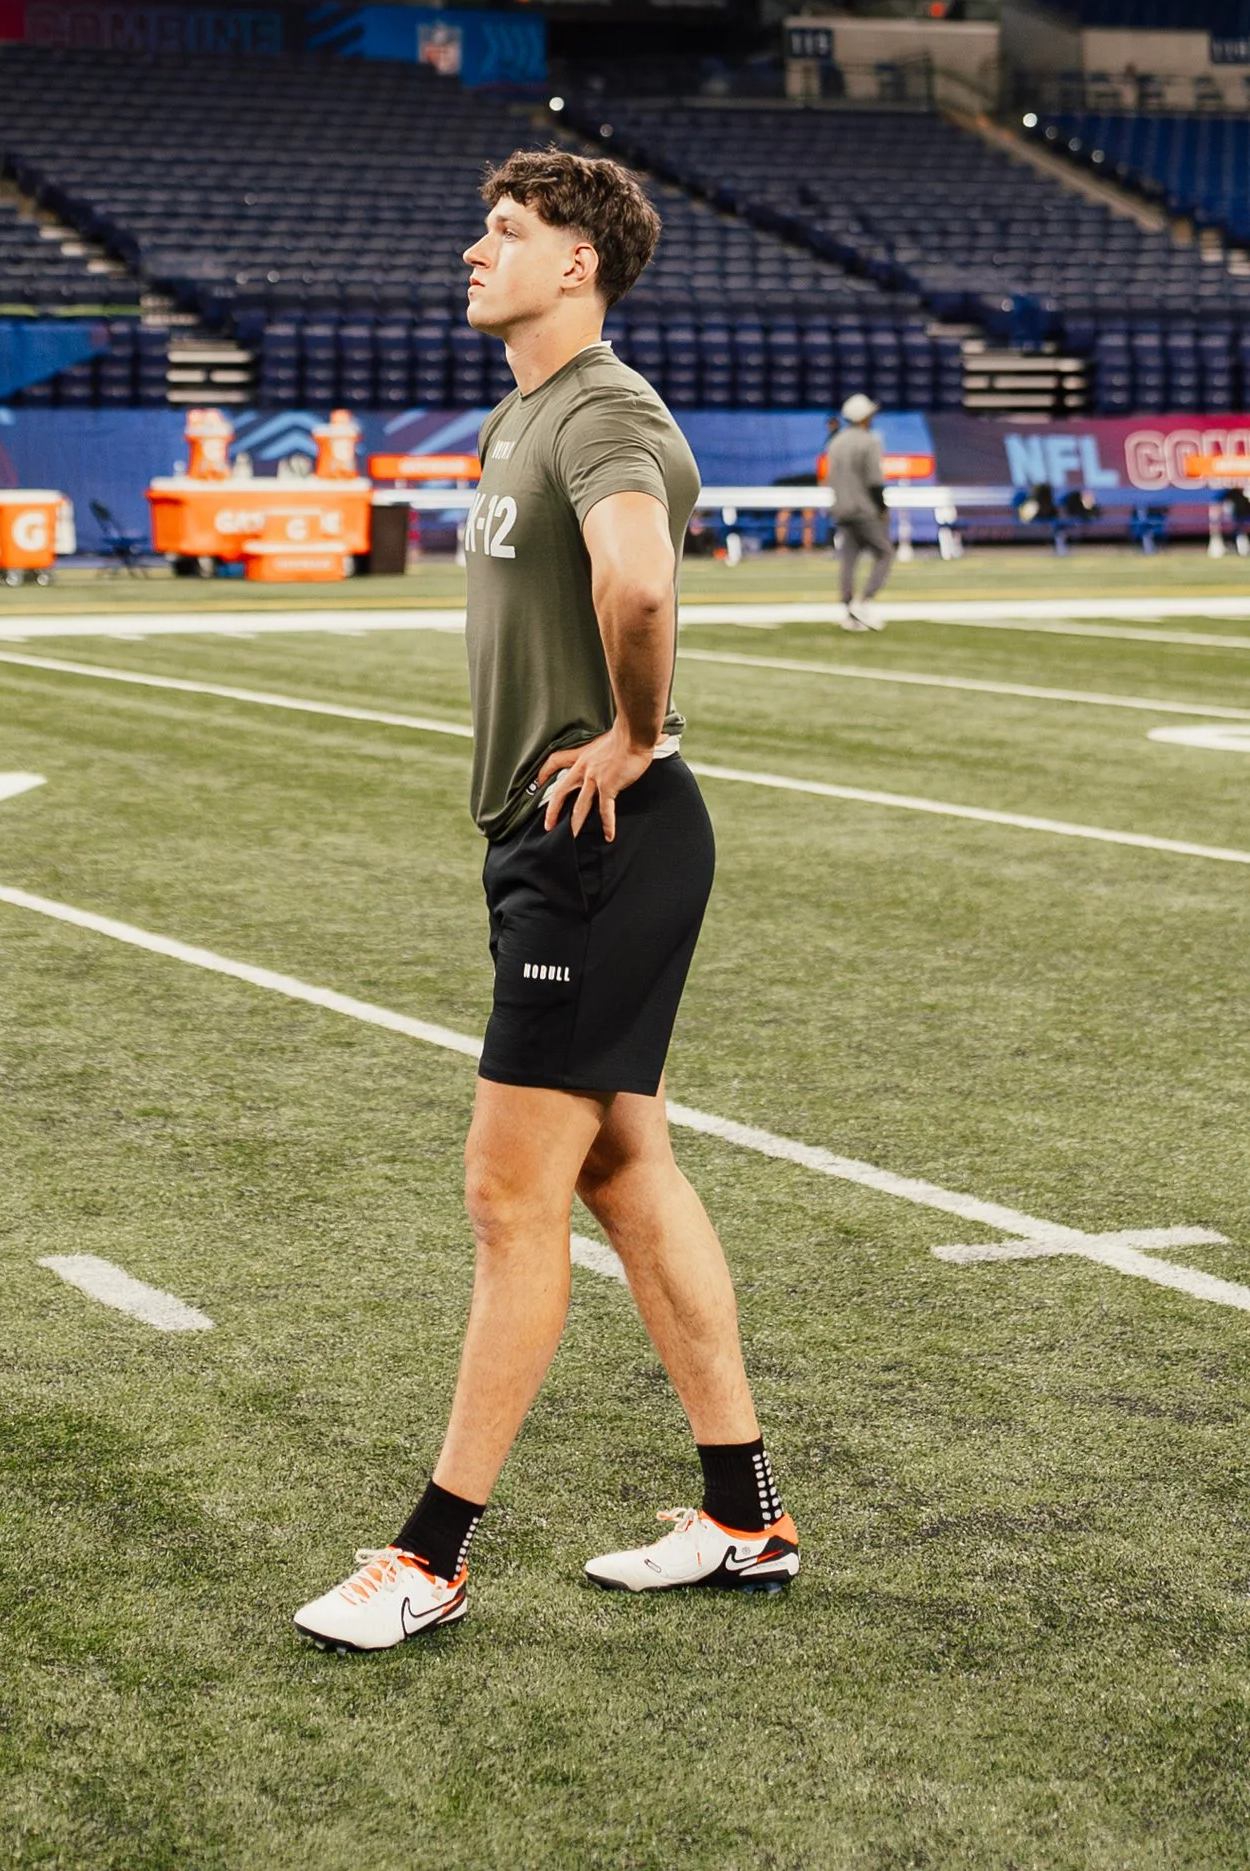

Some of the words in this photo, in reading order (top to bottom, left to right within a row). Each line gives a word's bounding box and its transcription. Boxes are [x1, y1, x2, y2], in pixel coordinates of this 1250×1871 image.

[1004, 432, 1119, 489] NFL
[13, 511, 48, 552] G
[523, 962, 571, 982] NOBULL
